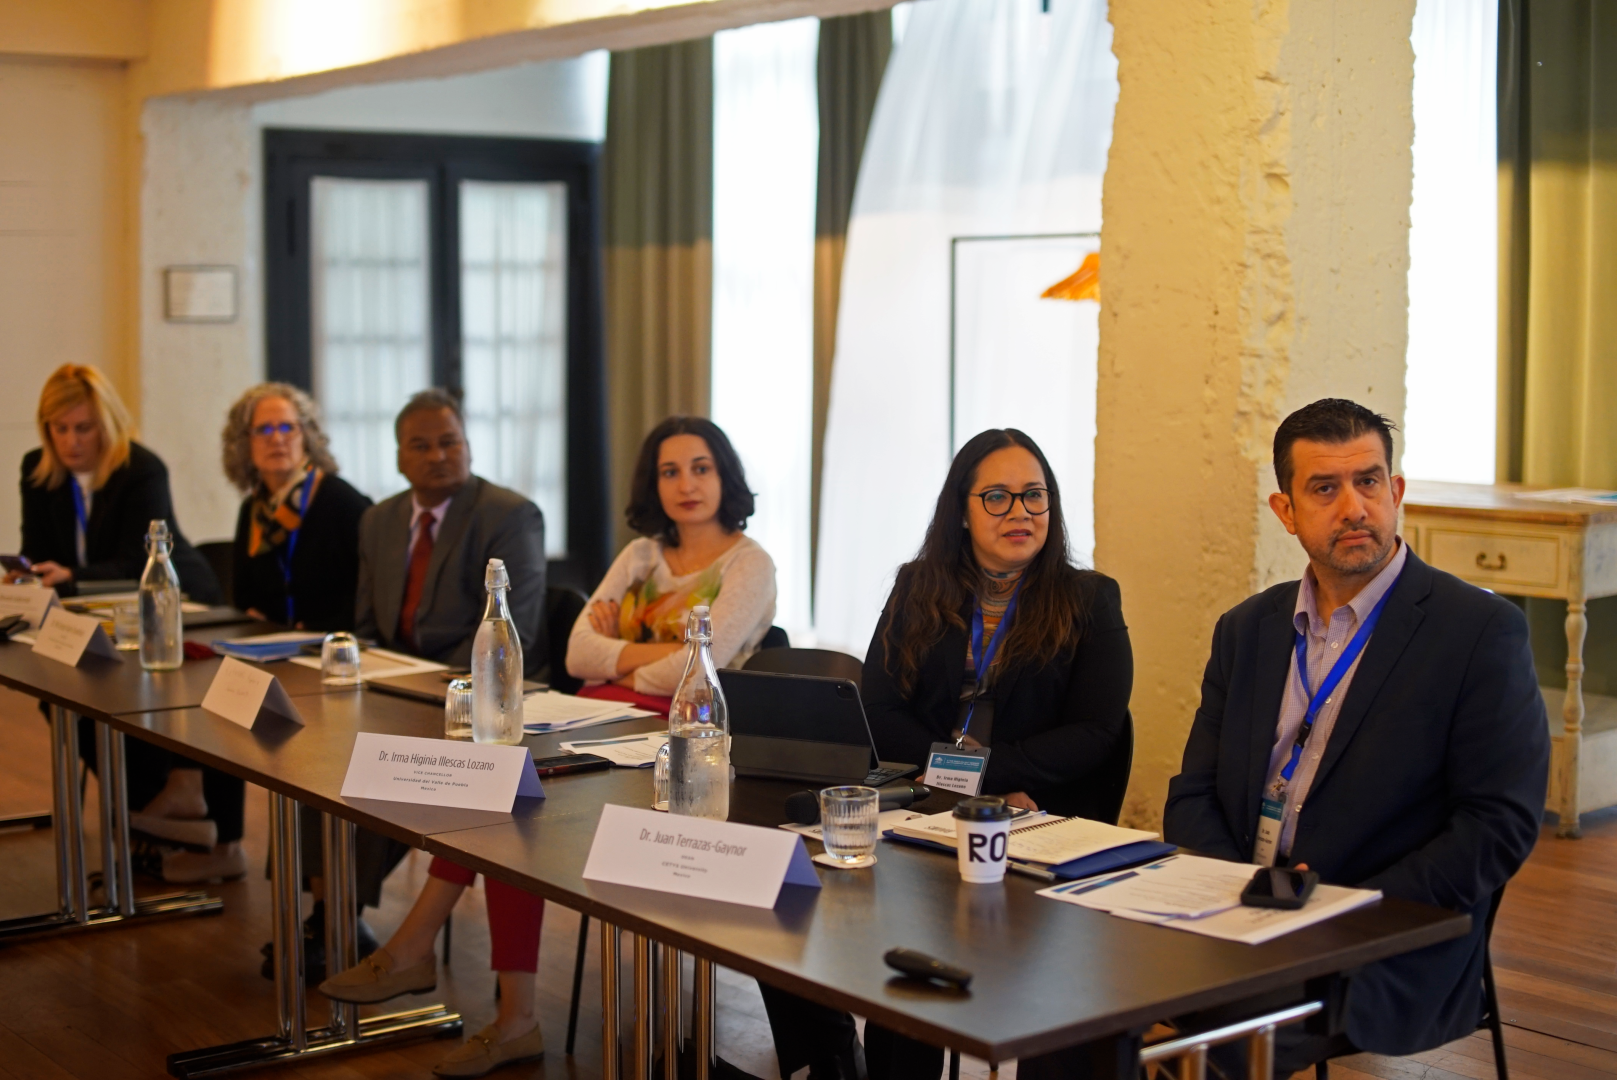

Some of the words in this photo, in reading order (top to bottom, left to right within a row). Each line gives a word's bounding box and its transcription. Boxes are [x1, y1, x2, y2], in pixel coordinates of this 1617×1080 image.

[378, 750, 389, 762] Dr.
[391, 752, 409, 764] Irma
[410, 753, 437, 767] Higinia
[438, 756, 465, 768] Illescas
[467, 759, 495, 771] Lozano
[640, 828, 651, 842] Dr.
[653, 831, 675, 846] Juan
[675, 834, 747, 857] Terrazas-Gaynor
